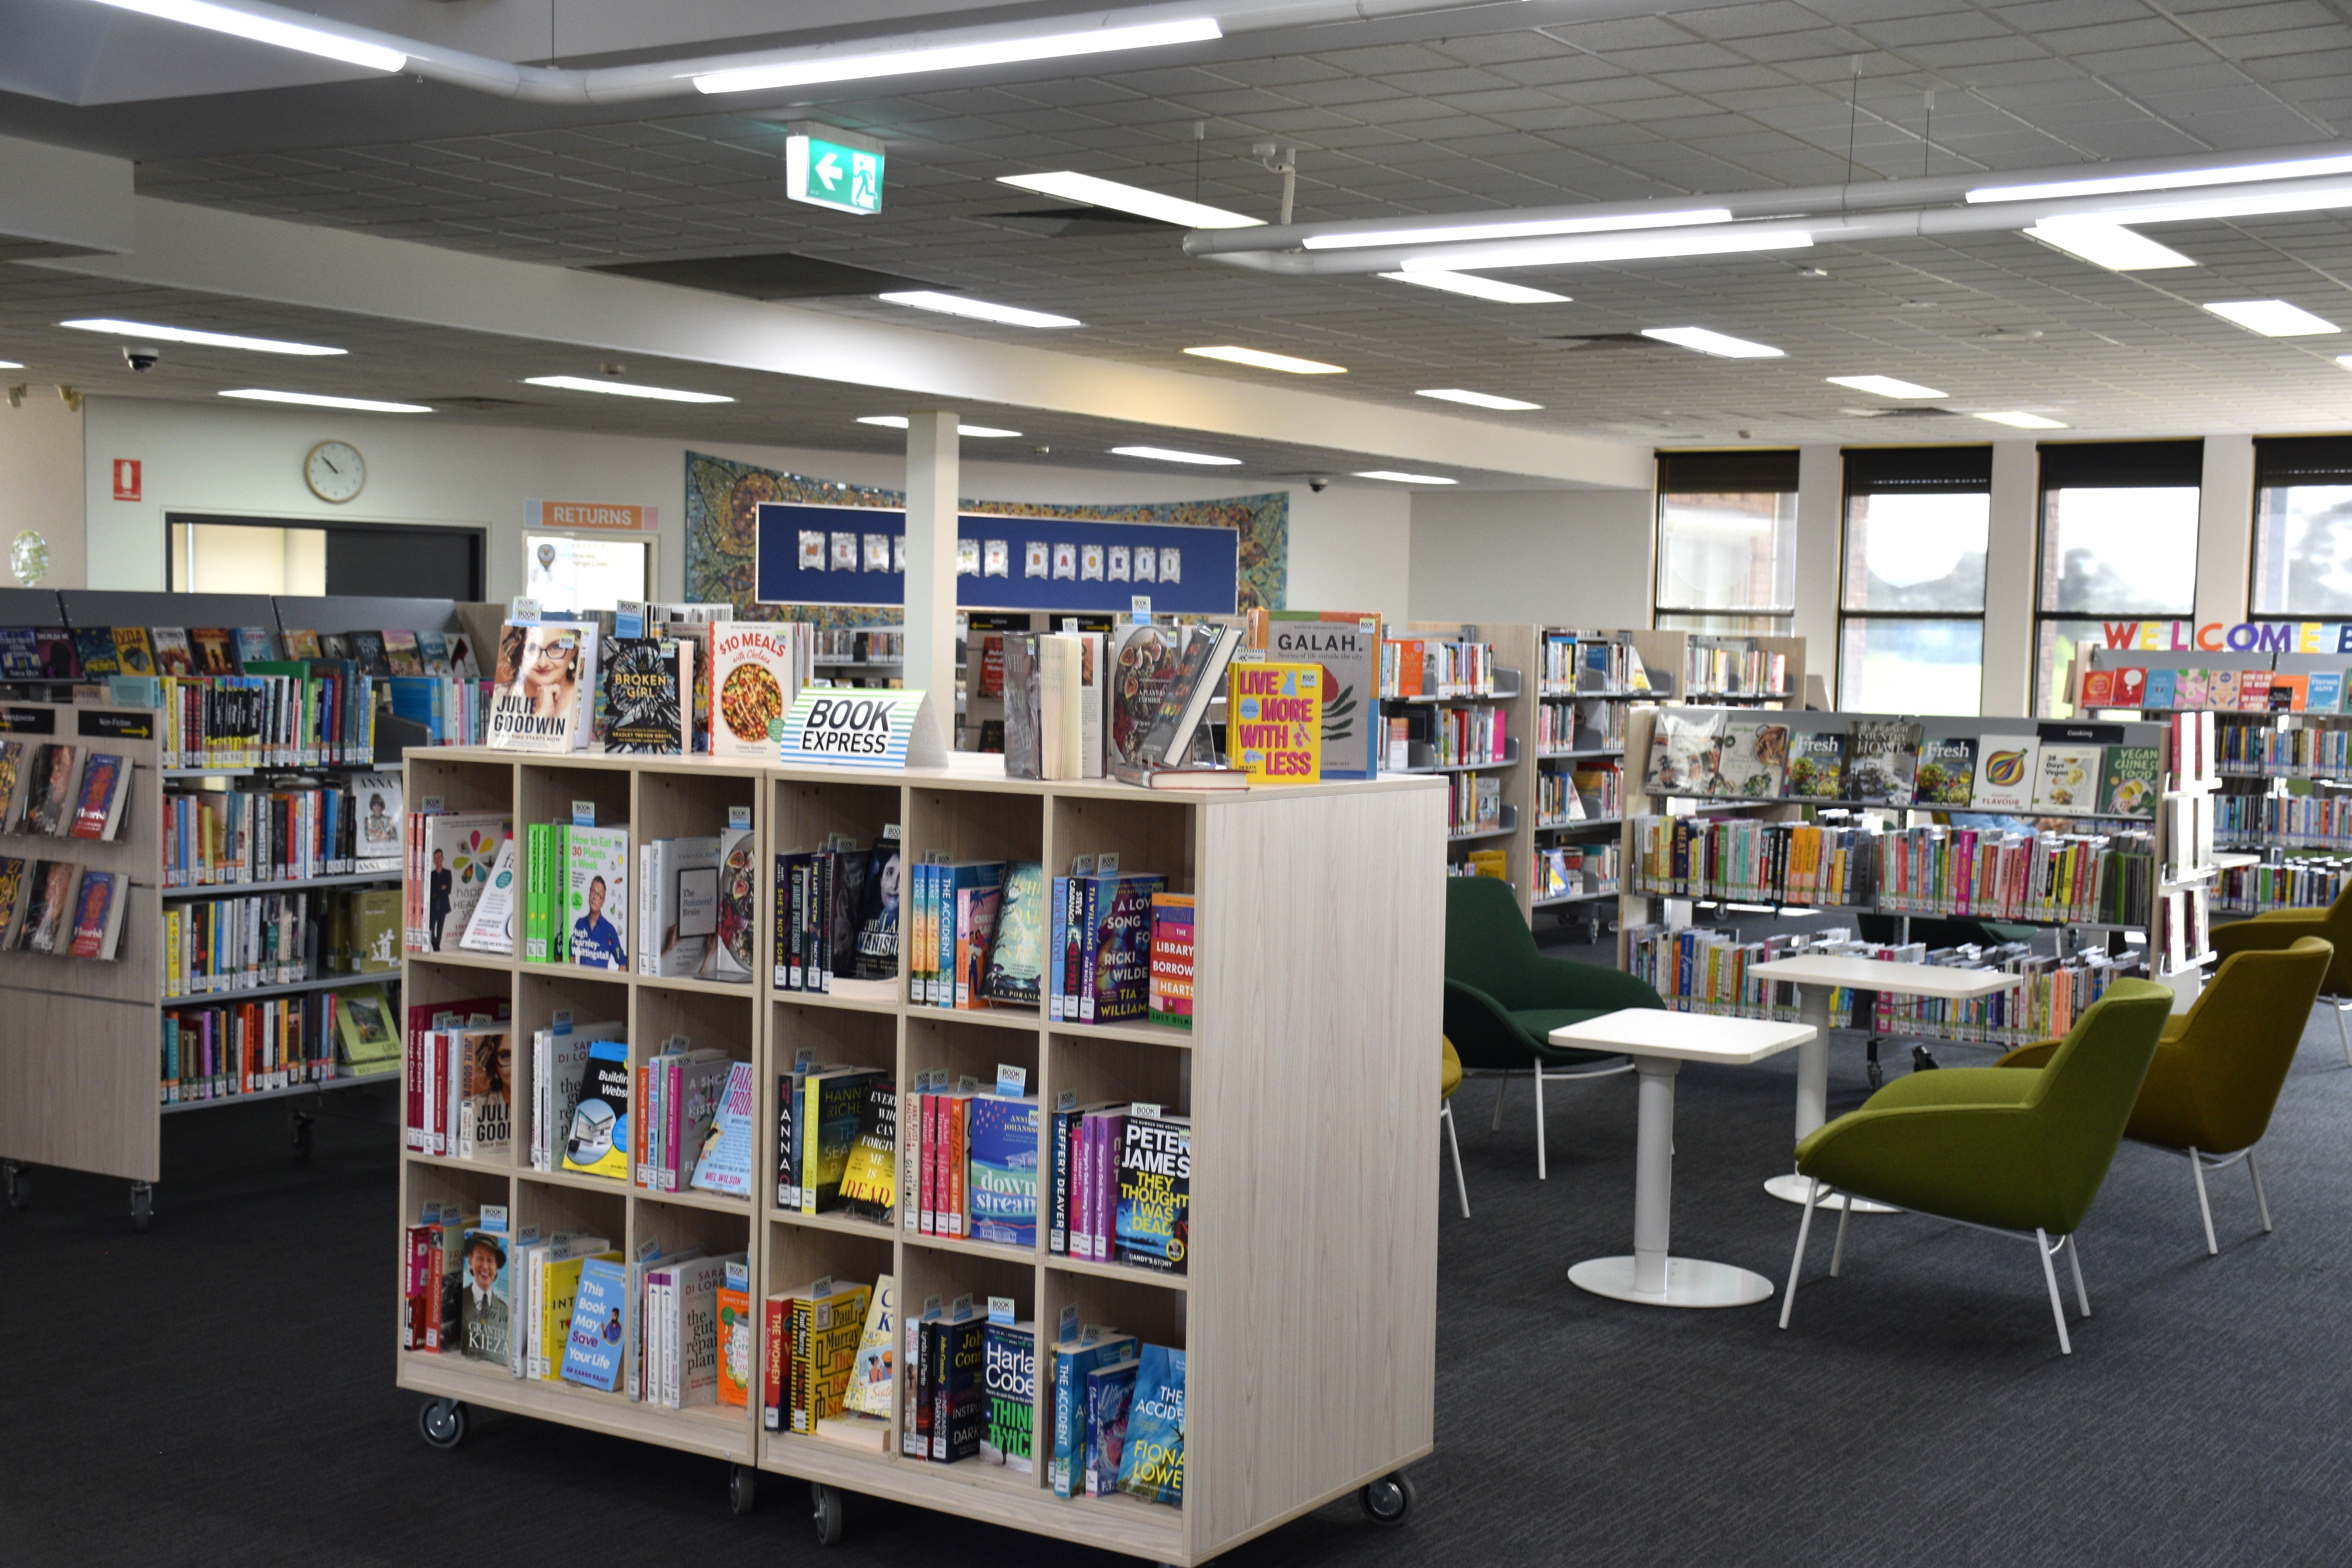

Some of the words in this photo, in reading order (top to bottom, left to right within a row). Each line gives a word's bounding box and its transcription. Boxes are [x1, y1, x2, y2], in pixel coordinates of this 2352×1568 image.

[554, 506, 632, 525] RETURNS
[1134, 600, 1147, 608] BOOK
[719, 636, 739, 655] $10
[742, 633, 786, 658] MEALS
[1278, 634, 1363, 652] GALAH.
[2103, 620, 2322, 653] WELCOME
[733, 650, 745, 663] with
[747, 649, 771, 664] Chelsea
[615, 674, 666, 686] BROKEN
[1240, 671, 1279, 695] LIVE
[626, 687, 655, 699] GIRL
[497, 696, 537, 715] JULIE
[1261, 698, 1314, 722] MORE
[494, 715, 566, 735] GOODWIN
[806, 699, 898, 733] BOOK
[802, 731, 888, 754] EXPRESS
[1239, 725, 1289, 748] WITH
[1798, 735, 1838, 752] Fresh
[1927, 740, 1969, 758] Fresh
[2121, 749, 2158, 759] VEGAN
[1266, 752, 1312, 776] LESS
[359, 778, 394, 789] ANNA
[2122, 770, 2152, 780] FOOD
[572, 834, 589, 845] How
[590, 836, 597, 846] to
[599, 837, 612, 848] Eat
[572, 846, 582, 857] 30
[583, 847, 606, 859] Plants
[579, 858, 598, 870] Week
[683, 889, 695, 897] The
[942, 878, 951, 899] THE
[683, 907, 700, 917] Brain
[942, 901, 951, 958] ACCIDENT
[1107, 916, 1141, 929] SONG
[571, 928, 588, 938] Hugh
[792, 911, 800, 954] PATTERSON
[571, 938, 600, 949] Fearnley-
[571, 949, 609, 961] Whittingstall
[1105, 952, 1135, 965] RICKI
[1113, 967, 1148, 981] WILDE
[1120, 989, 1137, 1000] TIA
[1002, 1068, 1020, 1078] BOOK
[690, 1079, 695, 1089] A
[1136, 1107, 1155, 1115] BOOK
[1139, 1120, 1154, 1128] NUMBER
[805, 1139, 813, 1168] PARTY
[1057, 1120, 1066, 1174] JEFFERY
[869, 1152, 884, 1165] ME
[1122, 1148, 1190, 1179] JAMES
[704, 1172, 717, 1182] MEL
[719, 1174, 742, 1186] WILSON
[867, 1167, 876, 1179] IS
[1136, 1171, 1174, 1191] THEY
[845, 1179, 891, 1206] DEAD
[1121, 1183, 1189, 1208] THOUGHT
[1056, 1178, 1065, 1229] DEAVER
[1132, 1201, 1136, 1214] I
[1140, 1202, 1174, 1221] WAS
[1132, 1216, 1172, 1236] DEAD
[584, 1281, 604, 1297] This
[579, 1298, 606, 1315] Book
[993, 1300, 1010, 1308] BOOK
[575, 1314, 601, 1332] May
[687, 1310, 706, 1327] the
[833, 1305, 854, 1325] Paul
[693, 1321, 713, 1340] gut
[772, 1314, 781, 1336] THE
[572, 1332, 599, 1348] Save
[826, 1328, 858, 1350] Murray
[569, 1348, 589, 1363] Your
[590, 1354, 610, 1369] Life
[688, 1353, 714, 1373] plan
[771, 1339, 781, 1385] WOMEN
[833, 1351, 851, 1370] The
[921, 1352, 927, 1361] La
[574, 1369, 591, 1378] KARAN
[592, 1374, 609, 1383] RAJAN
[1060, 1365, 1069, 1385] THE
[1161, 1385, 1183, 1404] THE
[1058, 1389, 1069, 1446] ACCIDENT
[1134, 1440, 1185, 1468] FIONA
[1133, 1461, 1183, 1489] LOWE
